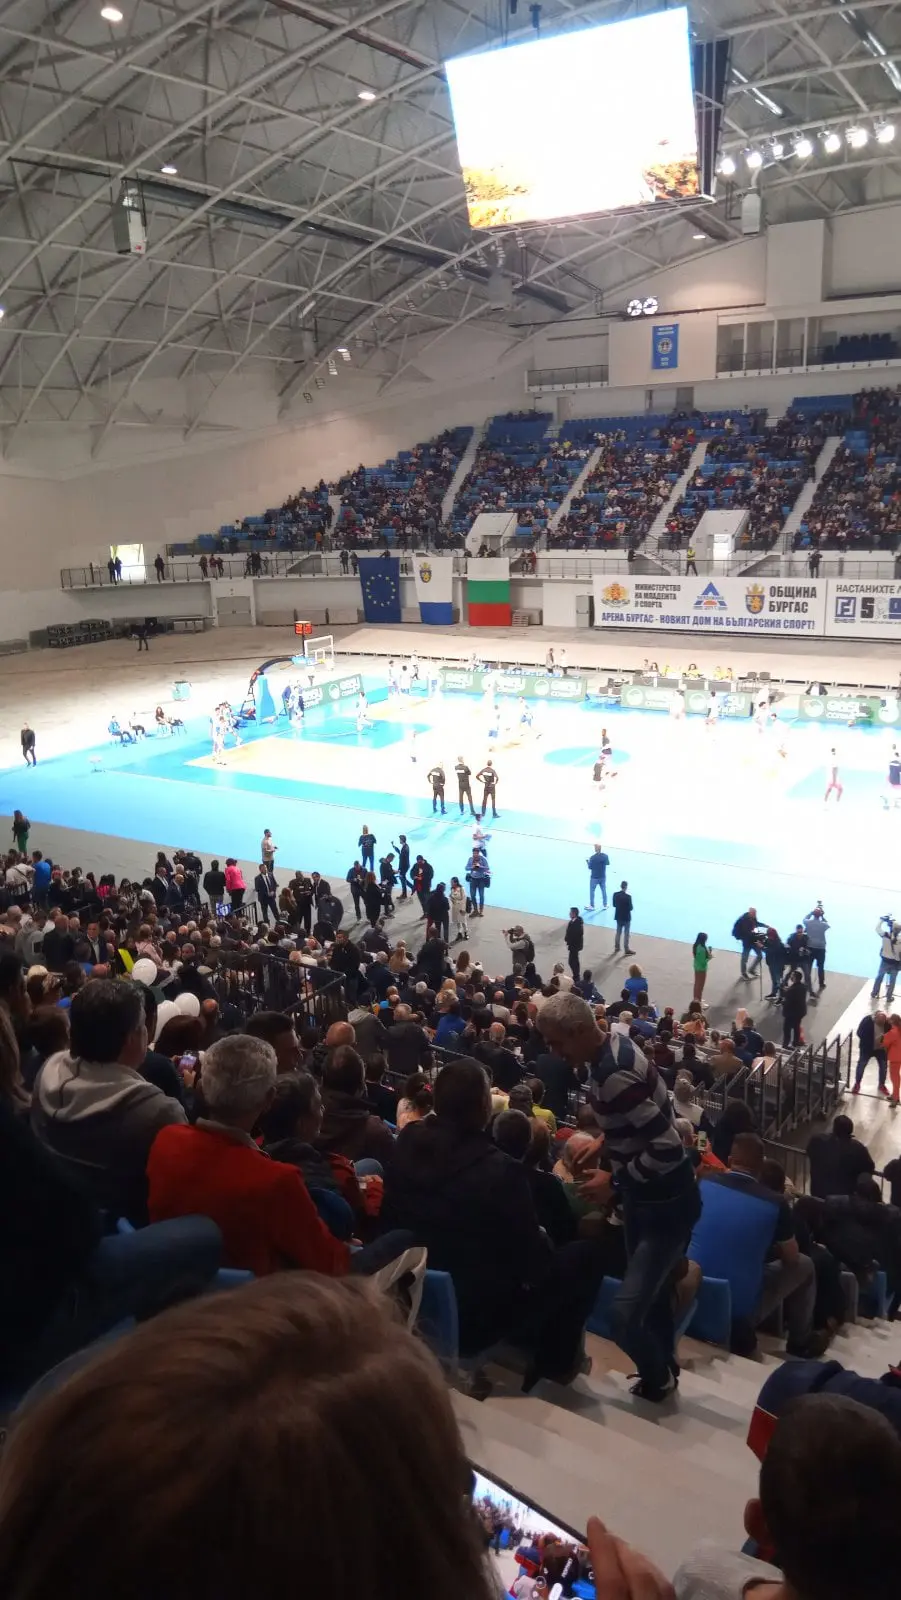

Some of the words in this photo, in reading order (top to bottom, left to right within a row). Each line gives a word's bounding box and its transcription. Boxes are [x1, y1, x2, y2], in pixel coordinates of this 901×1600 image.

[769, 586, 817, 599] ОБЩИНА
[836, 584, 895, 594] НАСТАНИХТЕ
[769, 601, 808, 613] БУРГАС
[601, 612, 625, 622] АРЕНА
[626, 613, 653, 623] БУРГАС
[660, 615, 691, 625] НОВИЯТ
[692, 616, 711, 627] ДОМ
[713, 617, 724, 626] НА
[726, 616, 781, 628] БЪЛГАРСКИЯ
[783, 619, 815, 630] СПОРТ!
